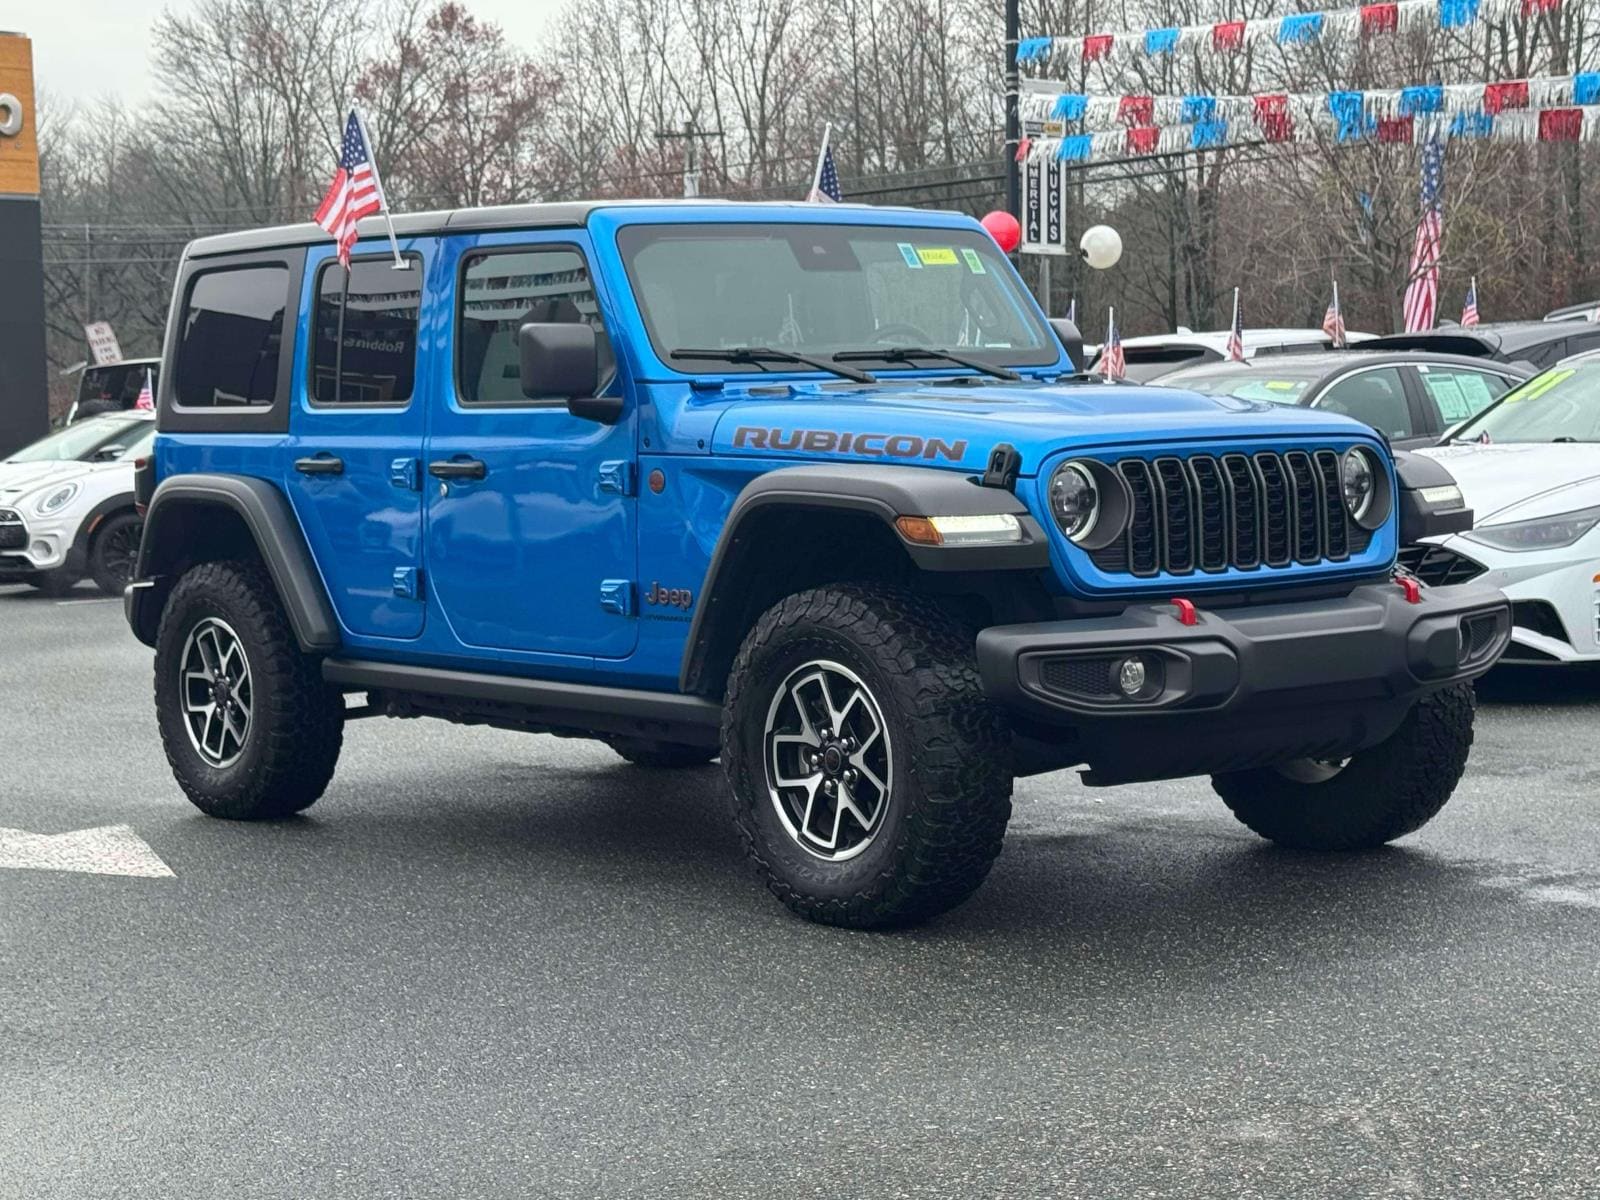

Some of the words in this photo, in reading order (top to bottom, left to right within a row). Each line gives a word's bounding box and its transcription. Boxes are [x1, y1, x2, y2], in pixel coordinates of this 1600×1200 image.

[1029, 160, 1040, 241] MERCIAL
[1049, 159, 1059, 240] RUCKS
[733, 426, 968, 462] RUBICON
[644, 580, 692, 612] Jeep
